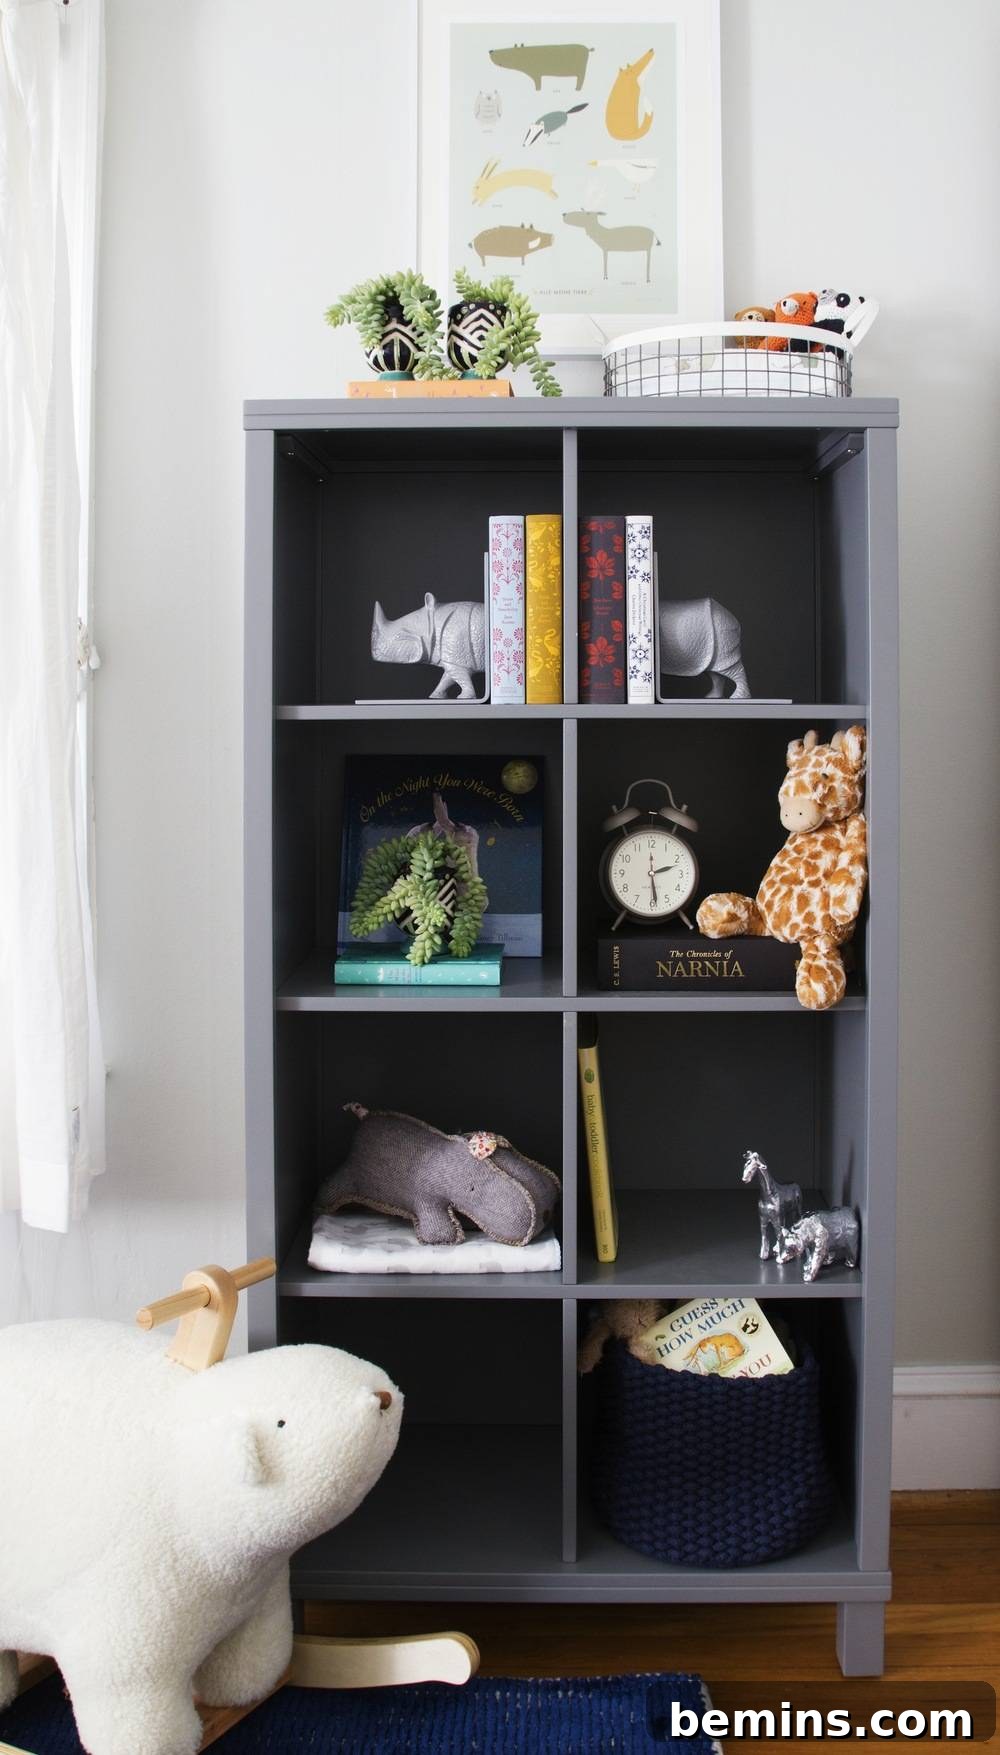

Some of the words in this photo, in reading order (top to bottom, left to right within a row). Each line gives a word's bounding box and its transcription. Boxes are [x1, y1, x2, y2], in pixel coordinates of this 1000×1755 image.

[359, 806, 376, 822] On
[377, 791, 393, 809] the
[395, 774, 430, 797] Night
[433, 773, 461, 789] You
[463, 779, 496, 799] Were
[494, 793, 525, 823] Born
[634, 843, 641, 853] 11
[648, 839, 656, 849] 12
[664, 843, 668, 853] 1
[622, 854, 631, 864] 10
[674, 854, 680, 864] 2
[619, 869, 625, 878] 9
[679, 870, 684, 879] 3
[622, 883, 629, 893] 8
[674, 884, 681, 892] 4
[633, 894, 640, 904] 7
[664, 894, 670, 904] 5
[670, 950, 684, 958] The
[686, 950, 722, 958] Chronicles
[724, 950, 734, 960] of
[655, 960, 745, 978] NARNIA
[590, 1122, 600, 1154] toddler
[669, 1297, 719, 1333] GUESS
[656, 1328, 694, 1358] HOW
[696, 1299, 746, 1335] MUCH
[740, 1354, 773, 1379] YOU
